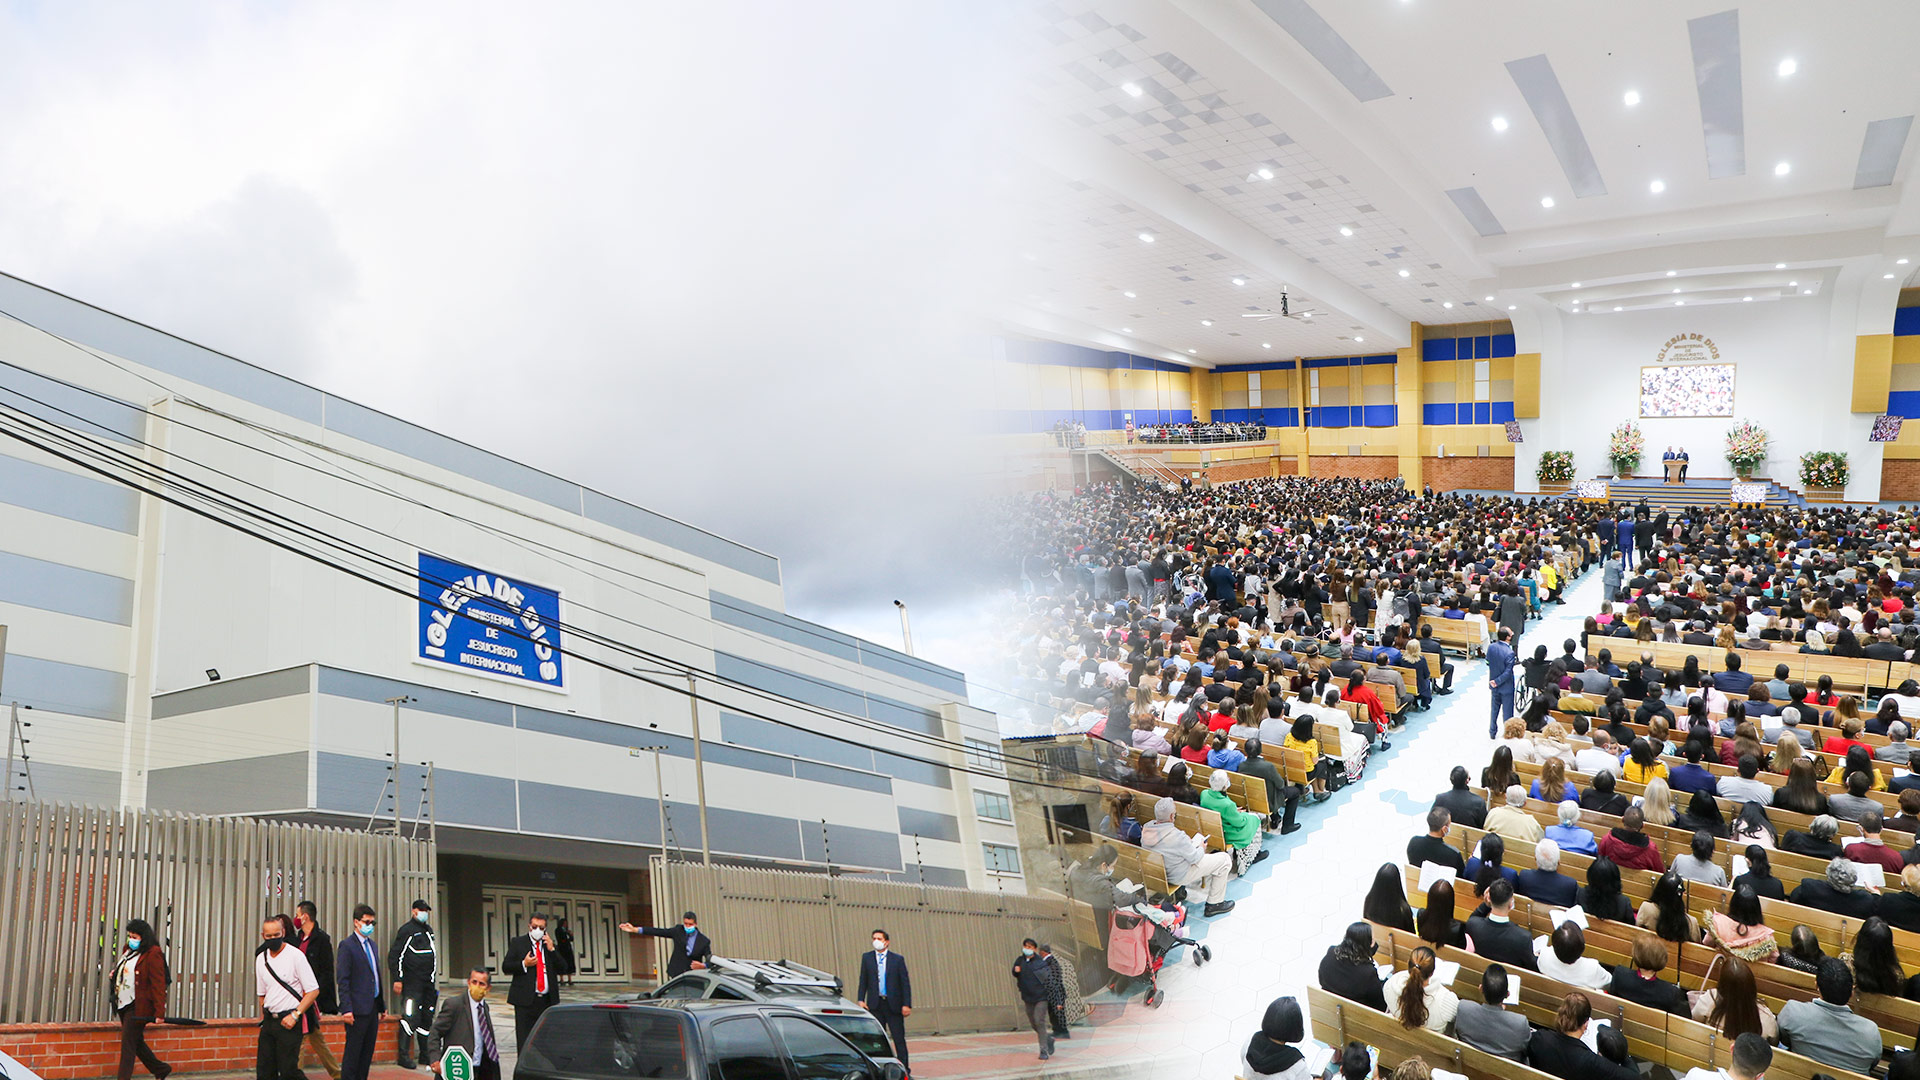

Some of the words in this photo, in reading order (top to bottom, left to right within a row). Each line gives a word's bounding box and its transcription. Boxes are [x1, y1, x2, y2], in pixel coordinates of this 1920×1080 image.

[1656, 333, 1687, 362] IGLESIA
[1690, 333, 1704, 342] DE
[1704, 338, 1720, 360] DIOS
[425, 574, 493, 658] IGLESIA
[493, 577, 525, 613] DE
[467, 607, 517, 629] MINISTERIAL
[485, 627, 499, 640] DE
[467, 639, 518, 659] JESUCRISTO
[460, 652, 526, 676] INTERNACIONAL
